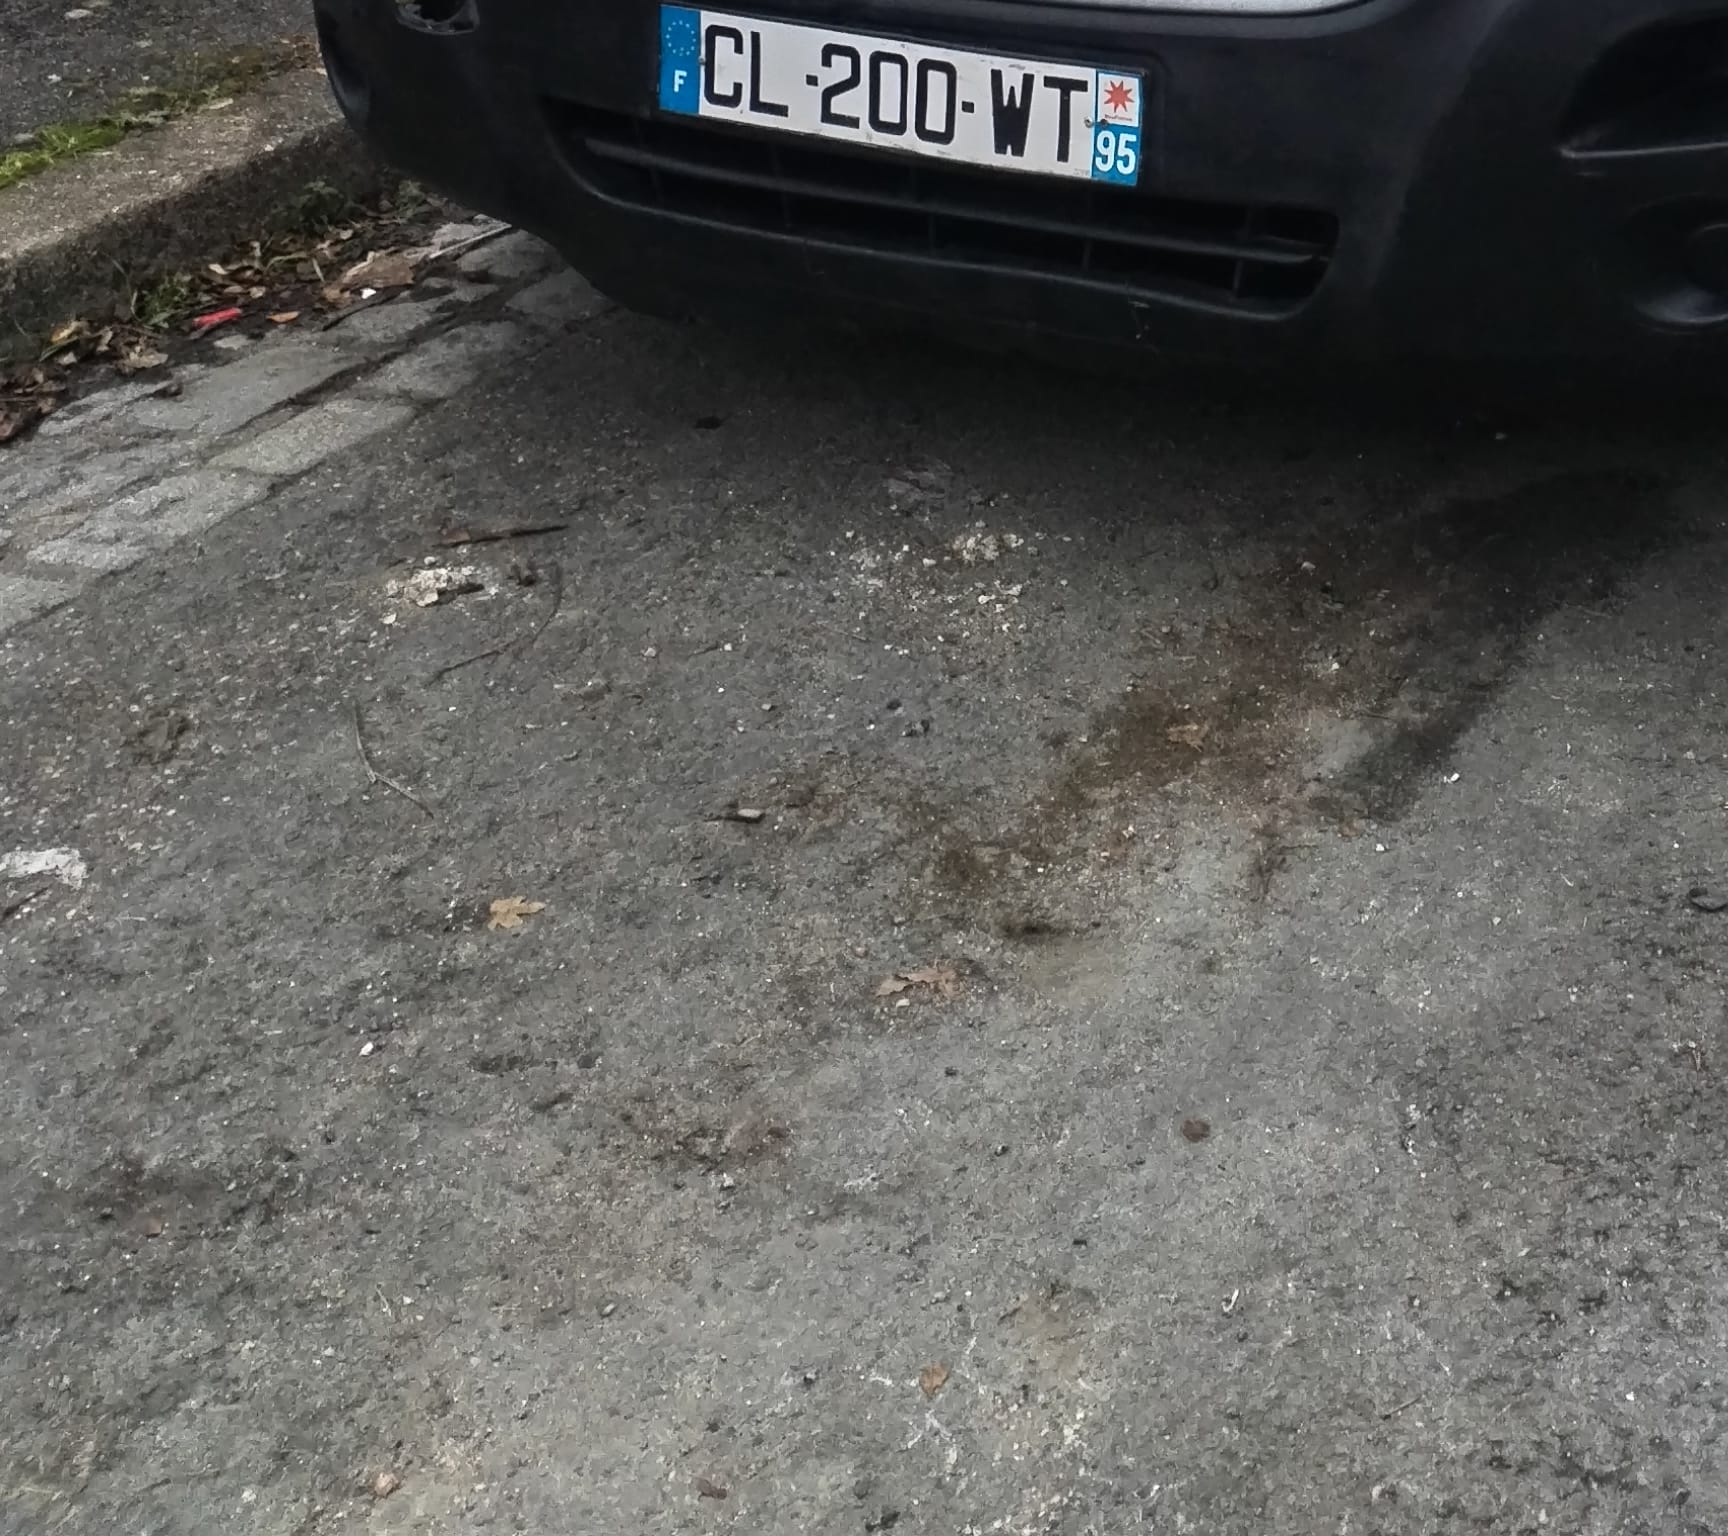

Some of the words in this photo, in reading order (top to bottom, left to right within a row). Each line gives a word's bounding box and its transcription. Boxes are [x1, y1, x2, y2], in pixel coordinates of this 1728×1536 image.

[674, 69, 688, 93] F
[703, 24, 1089, 163] CL-200-WT
[1095, 130, 1137, 175] 95
